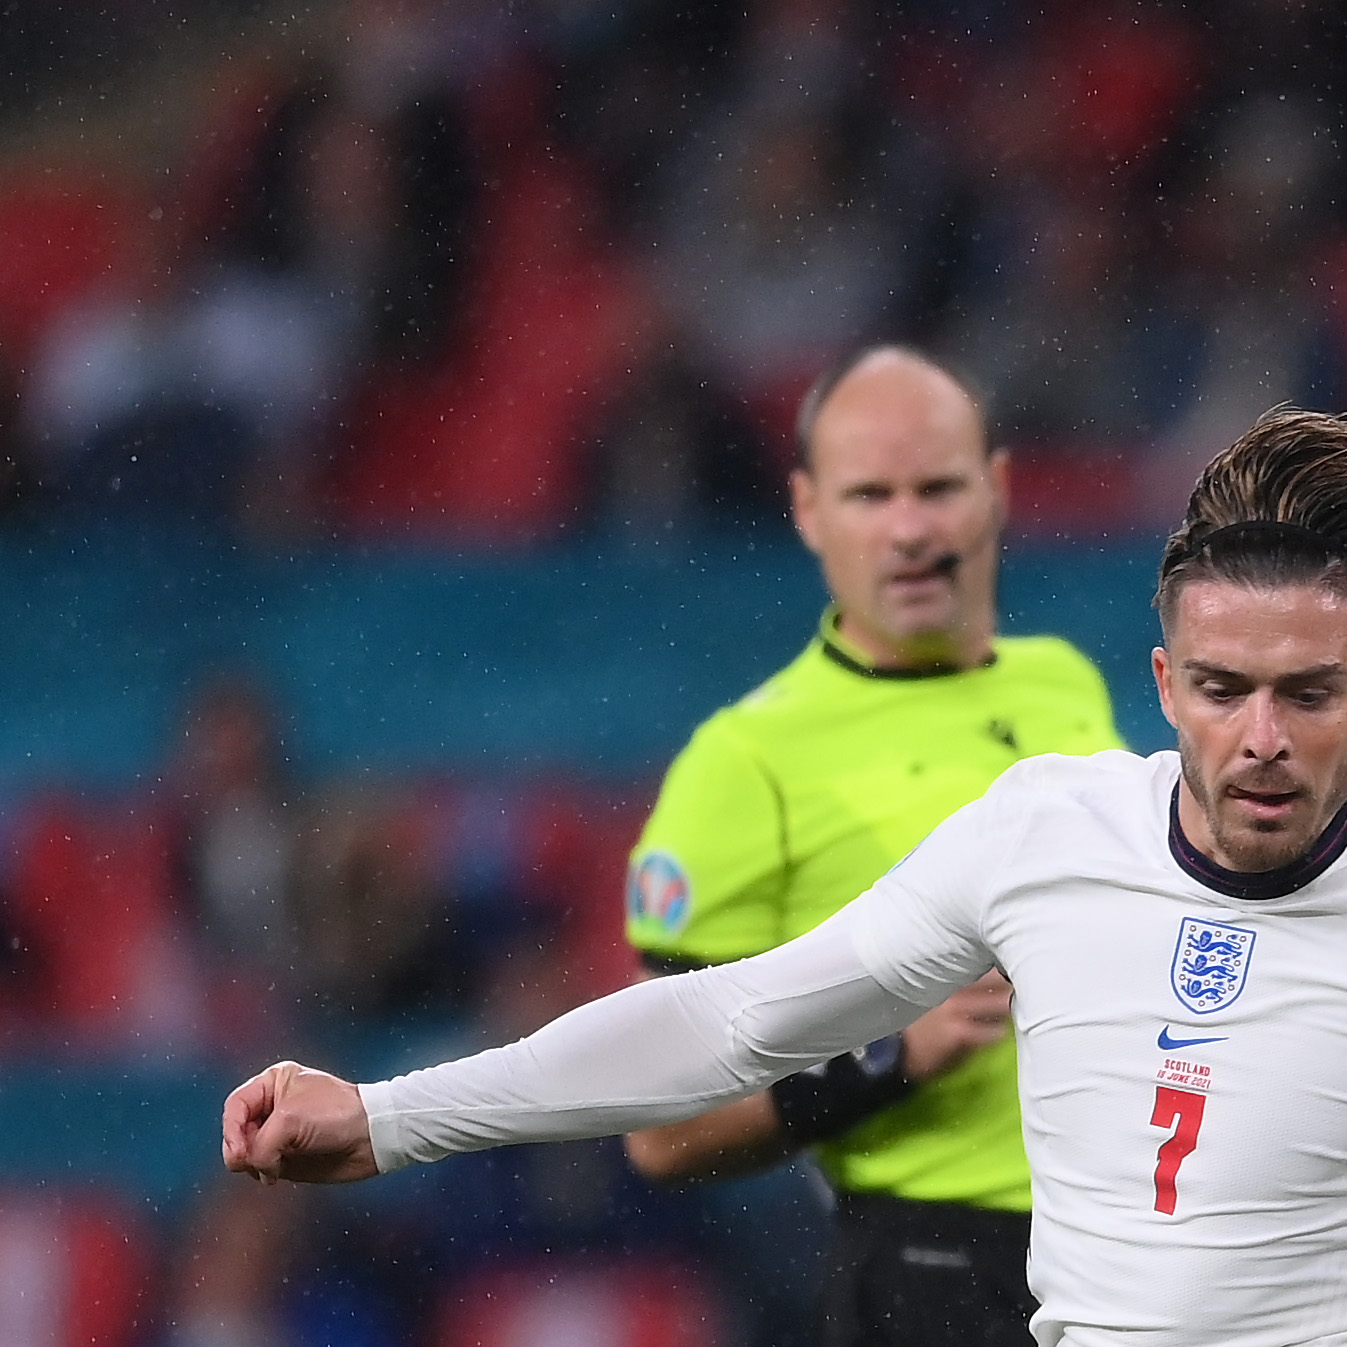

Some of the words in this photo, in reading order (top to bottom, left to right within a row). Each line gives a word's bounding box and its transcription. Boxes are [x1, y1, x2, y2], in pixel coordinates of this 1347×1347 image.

[1164, 1059, 1211, 1077] SCOTLAND
[1167, 1073, 1191, 1084] JUNE
[1190, 1076, 1212, 1089] 2021
[1151, 1086, 1207, 1216] 7
